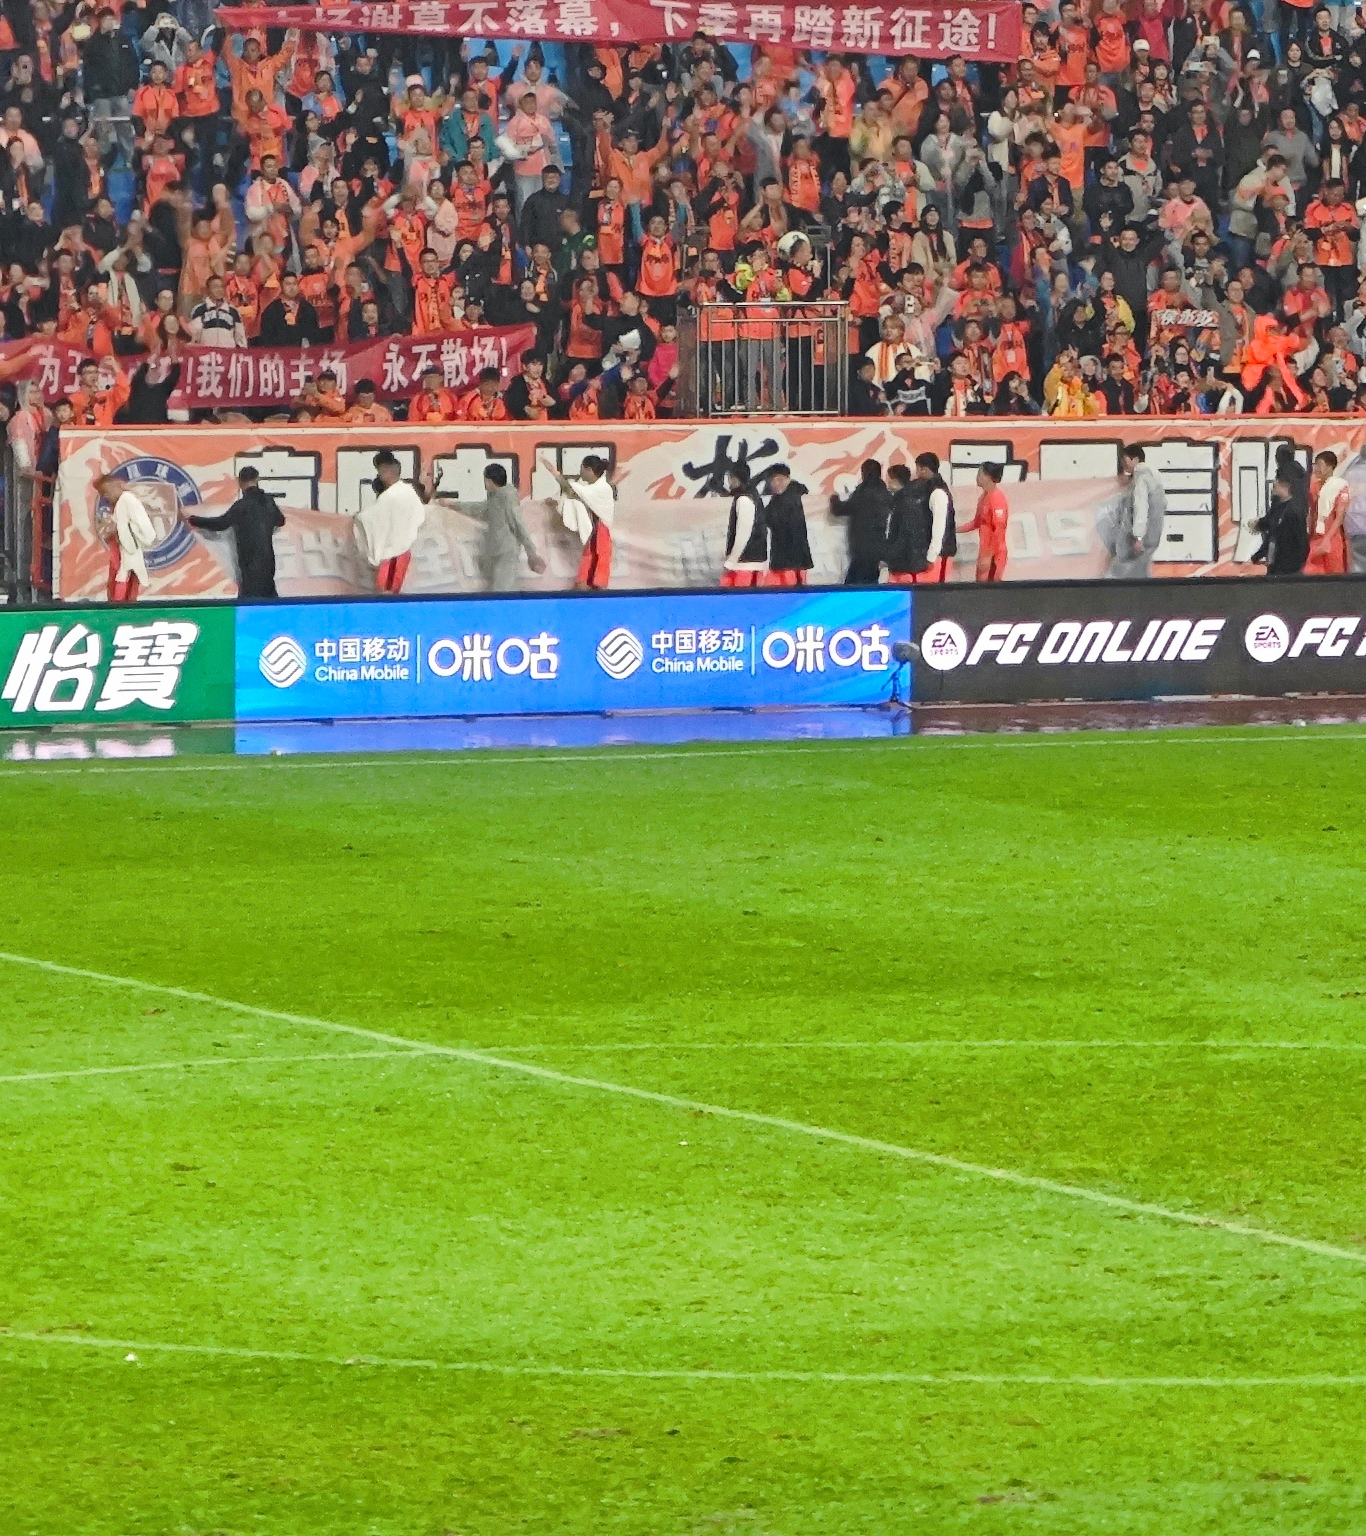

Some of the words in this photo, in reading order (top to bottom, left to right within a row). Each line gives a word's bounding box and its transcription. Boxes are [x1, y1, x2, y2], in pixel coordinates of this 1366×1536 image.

[314, 636, 411, 664] 中国移动
[427, 631, 560, 681] 咪咕
[651, 627, 745, 656] 中国移动
[761, 624, 891, 673] 咪咕
[966, 623, 1044, 665] FC
[1037, 618, 1227, 663] ONLINE
[1288, 618, 1360, 659] FC
[0, 620, 202, 715] 怡寶
[314, 664, 360, 683] China
[360, 662, 410, 682] Mobile
[651, 656, 695, 675] China
[696, 655, 745, 674] Mobile
